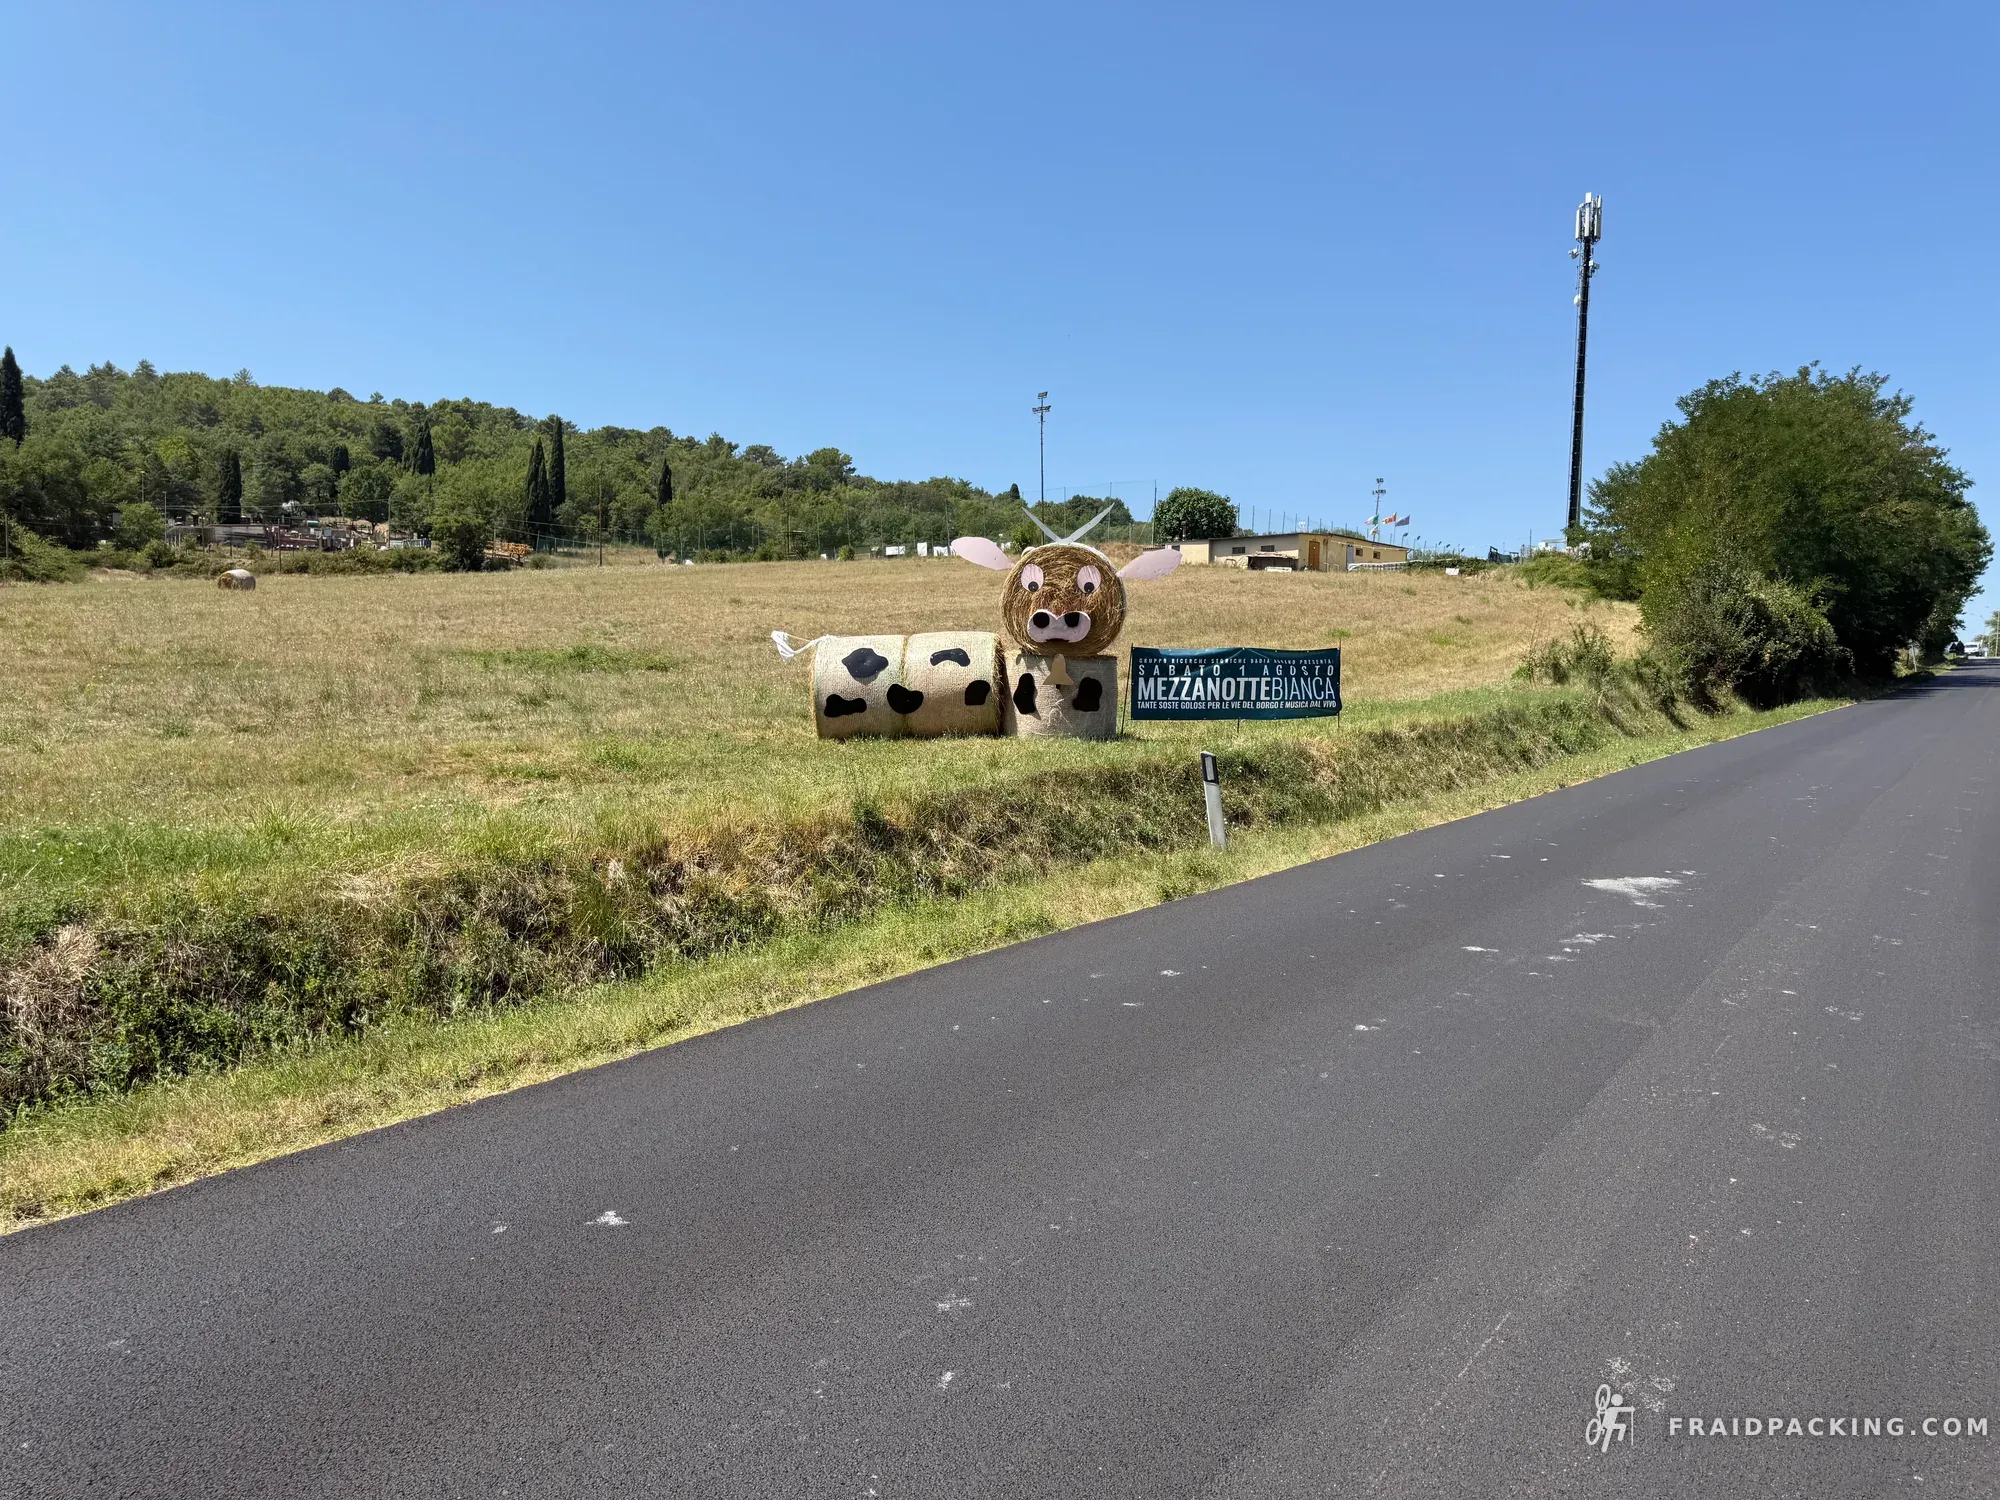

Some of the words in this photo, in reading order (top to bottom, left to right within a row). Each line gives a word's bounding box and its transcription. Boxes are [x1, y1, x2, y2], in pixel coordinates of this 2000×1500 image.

[1139, 664, 1220, 676] SABATO
[1239, 665, 1245, 676] 1
[1263, 665, 1334, 676] AGOSTO
[1256, 701, 1278, 709] BORGO
